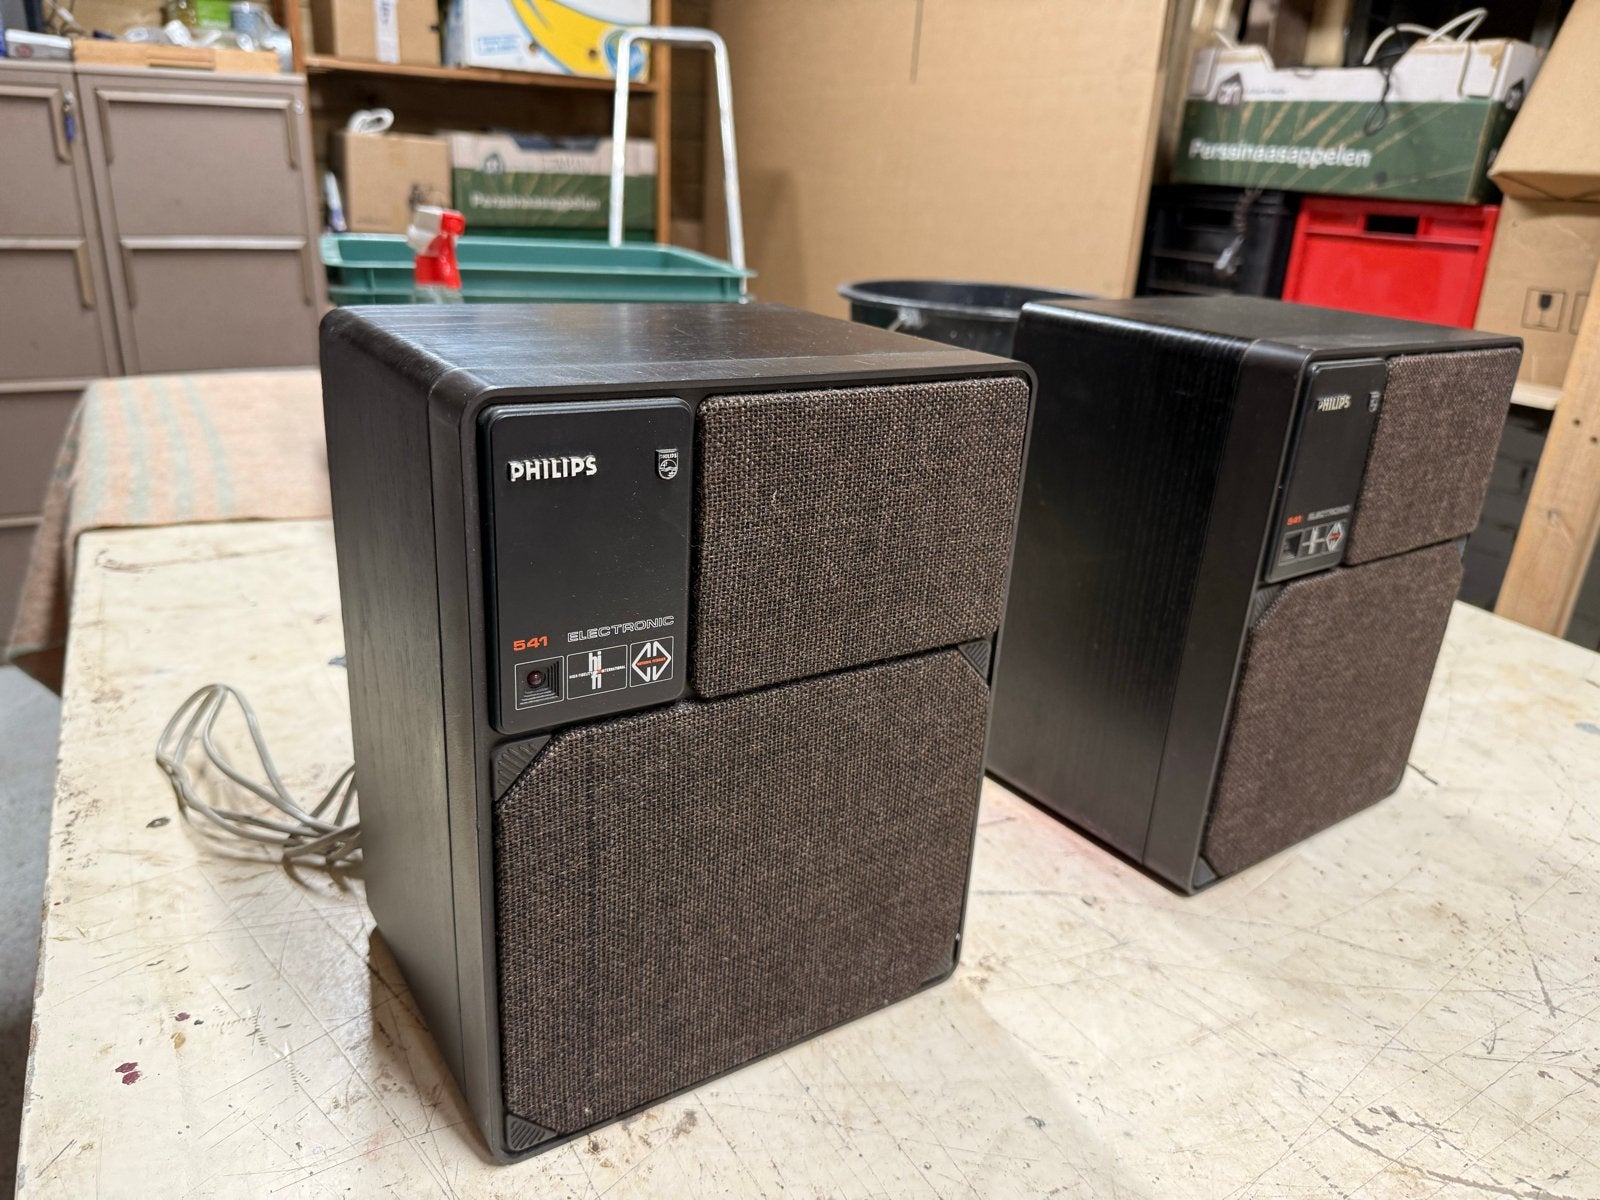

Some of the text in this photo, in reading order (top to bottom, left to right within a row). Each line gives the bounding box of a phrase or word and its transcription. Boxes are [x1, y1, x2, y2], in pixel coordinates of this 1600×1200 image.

[1317, 394, 1351, 411] PHILIPS
[508, 455, 598, 482] PHILIPS
[567, 615, 675, 643] ELECTRONIC
[513, 636, 548, 651] 541
